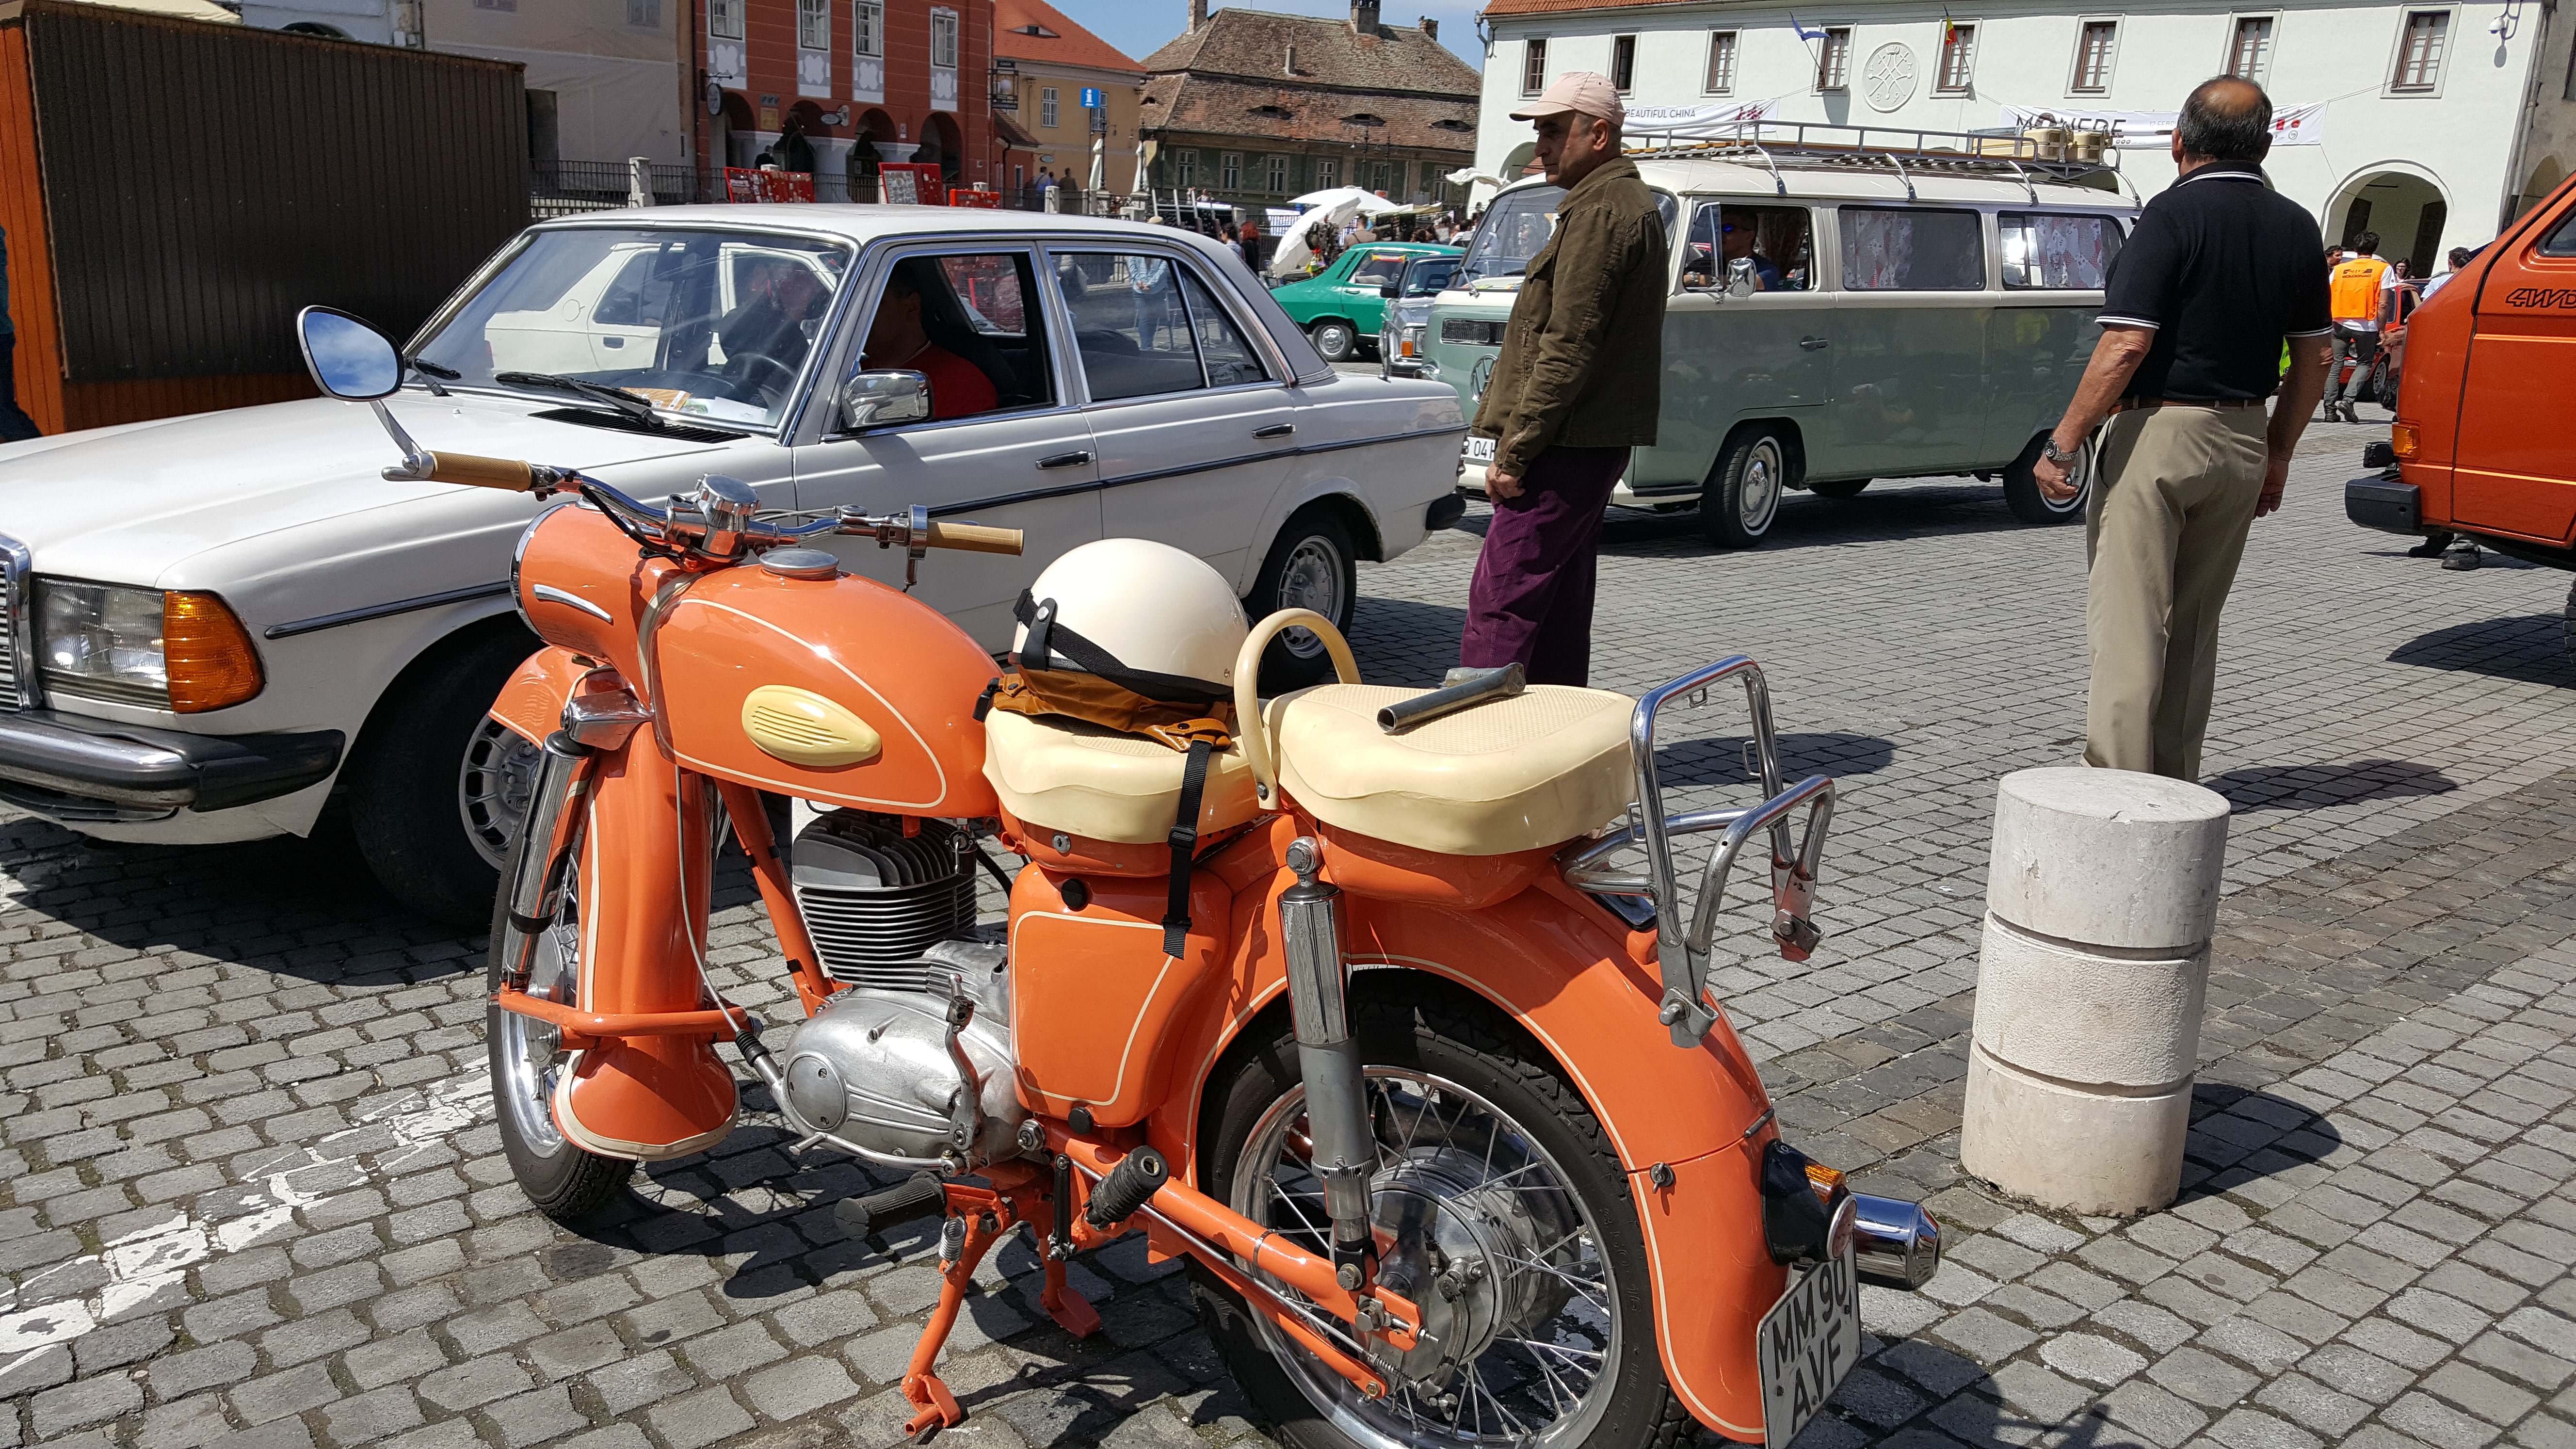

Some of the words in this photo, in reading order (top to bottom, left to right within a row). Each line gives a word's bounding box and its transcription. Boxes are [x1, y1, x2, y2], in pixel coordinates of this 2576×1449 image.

[1625, 109, 1667, 118] BEAUTIFUL
[1670, 109, 1696, 118] CHINA
[2505, 288, 2576, 308] 4WD
[1772, 1279, 1816, 1381] MM
[1819, 1254, 1847, 1323] 90
[1791, 1318, 1842, 1436] AVF
